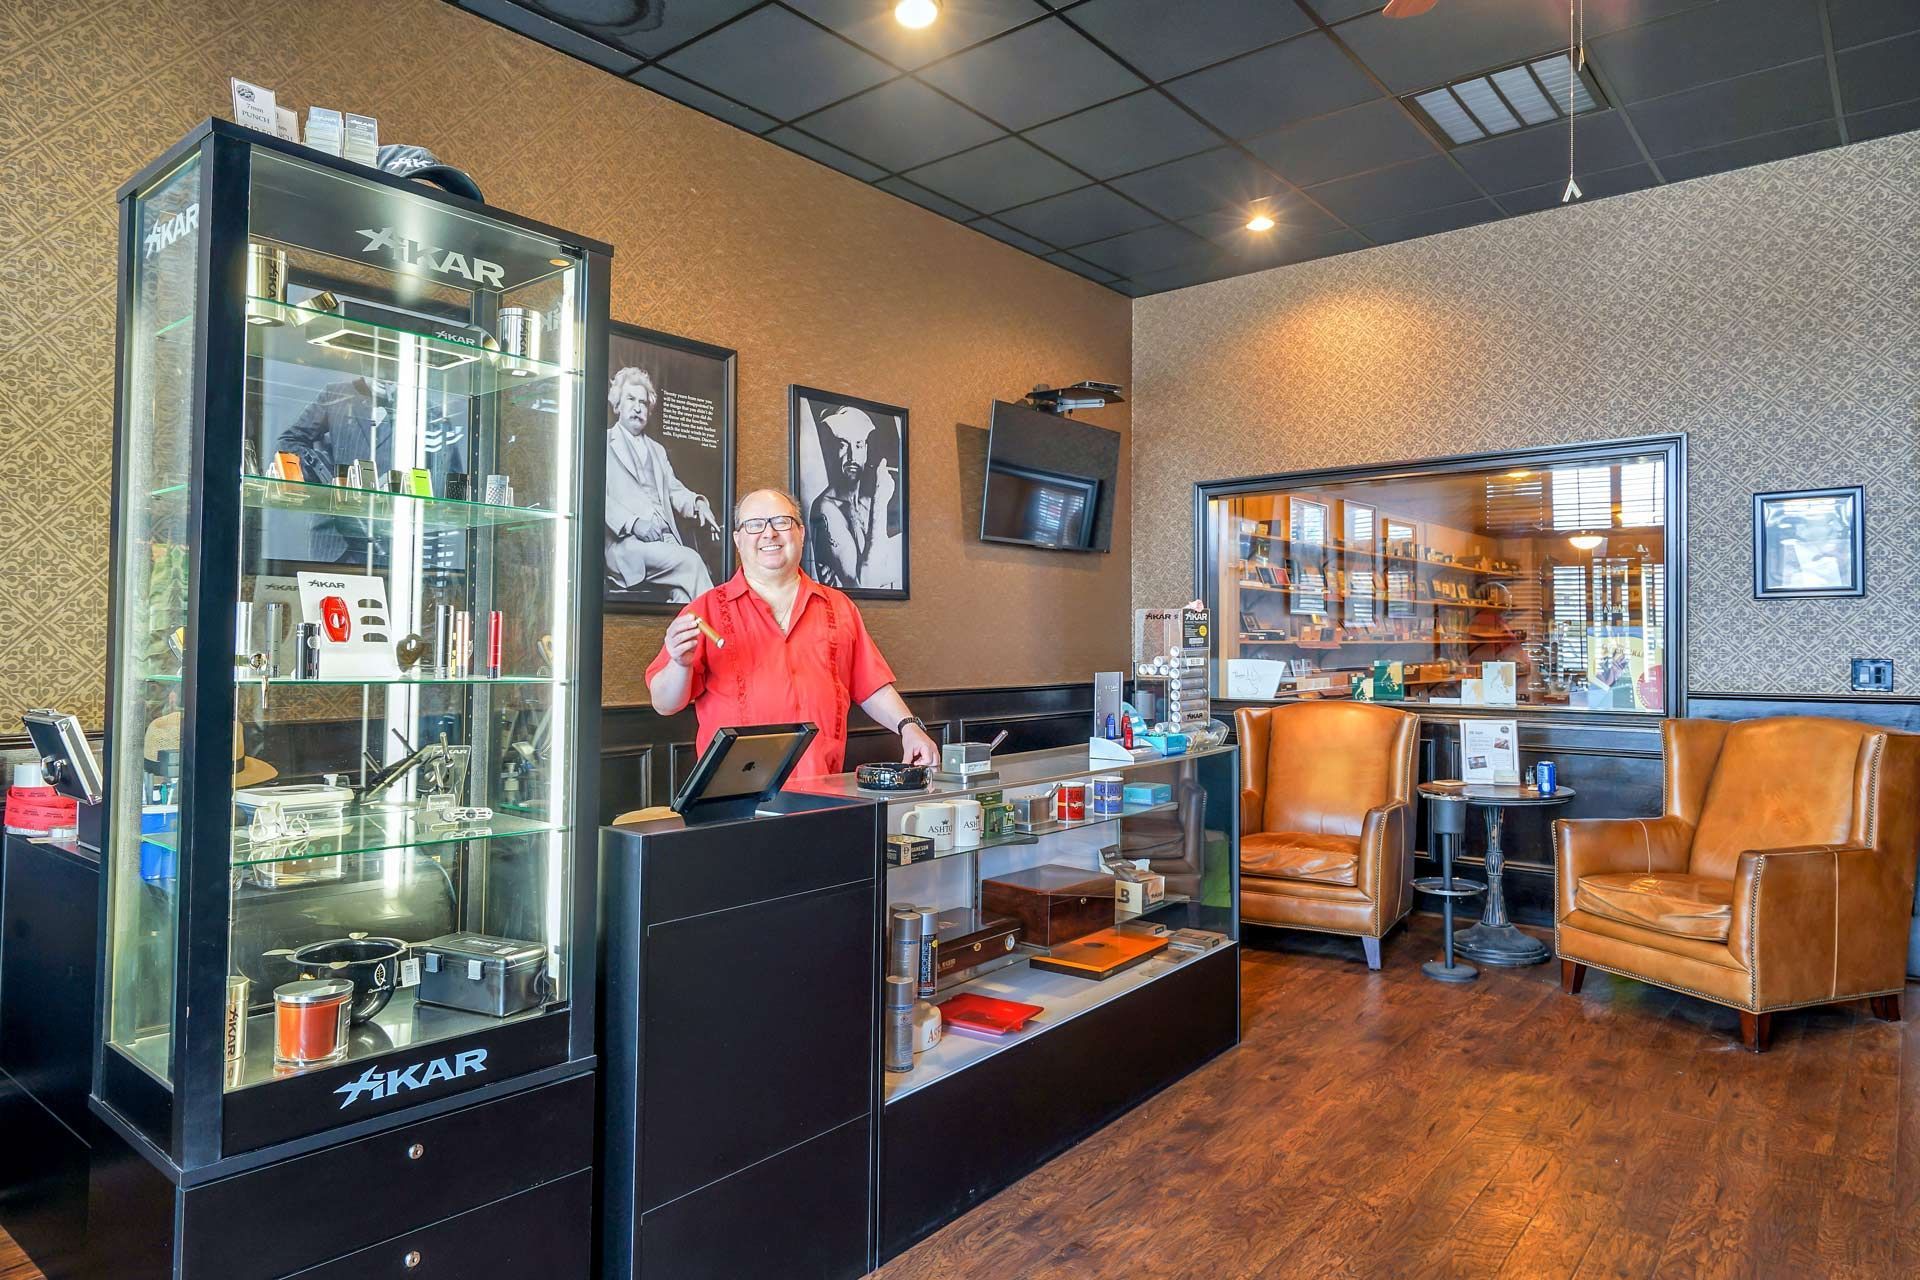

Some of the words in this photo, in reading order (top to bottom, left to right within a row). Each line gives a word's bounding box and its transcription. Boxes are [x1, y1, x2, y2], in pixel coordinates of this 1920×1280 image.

[242, 110, 270, 124] PUNCH
[144, 203, 199, 259] XIKAR
[355, 227, 505, 288] XIKAR
[434, 330, 476, 346] XIKAR
[308, 579, 345, 589] XIKAR
[226, 1008, 239, 1056] XIKAR
[333, 1049, 488, 1110] XIKAR
